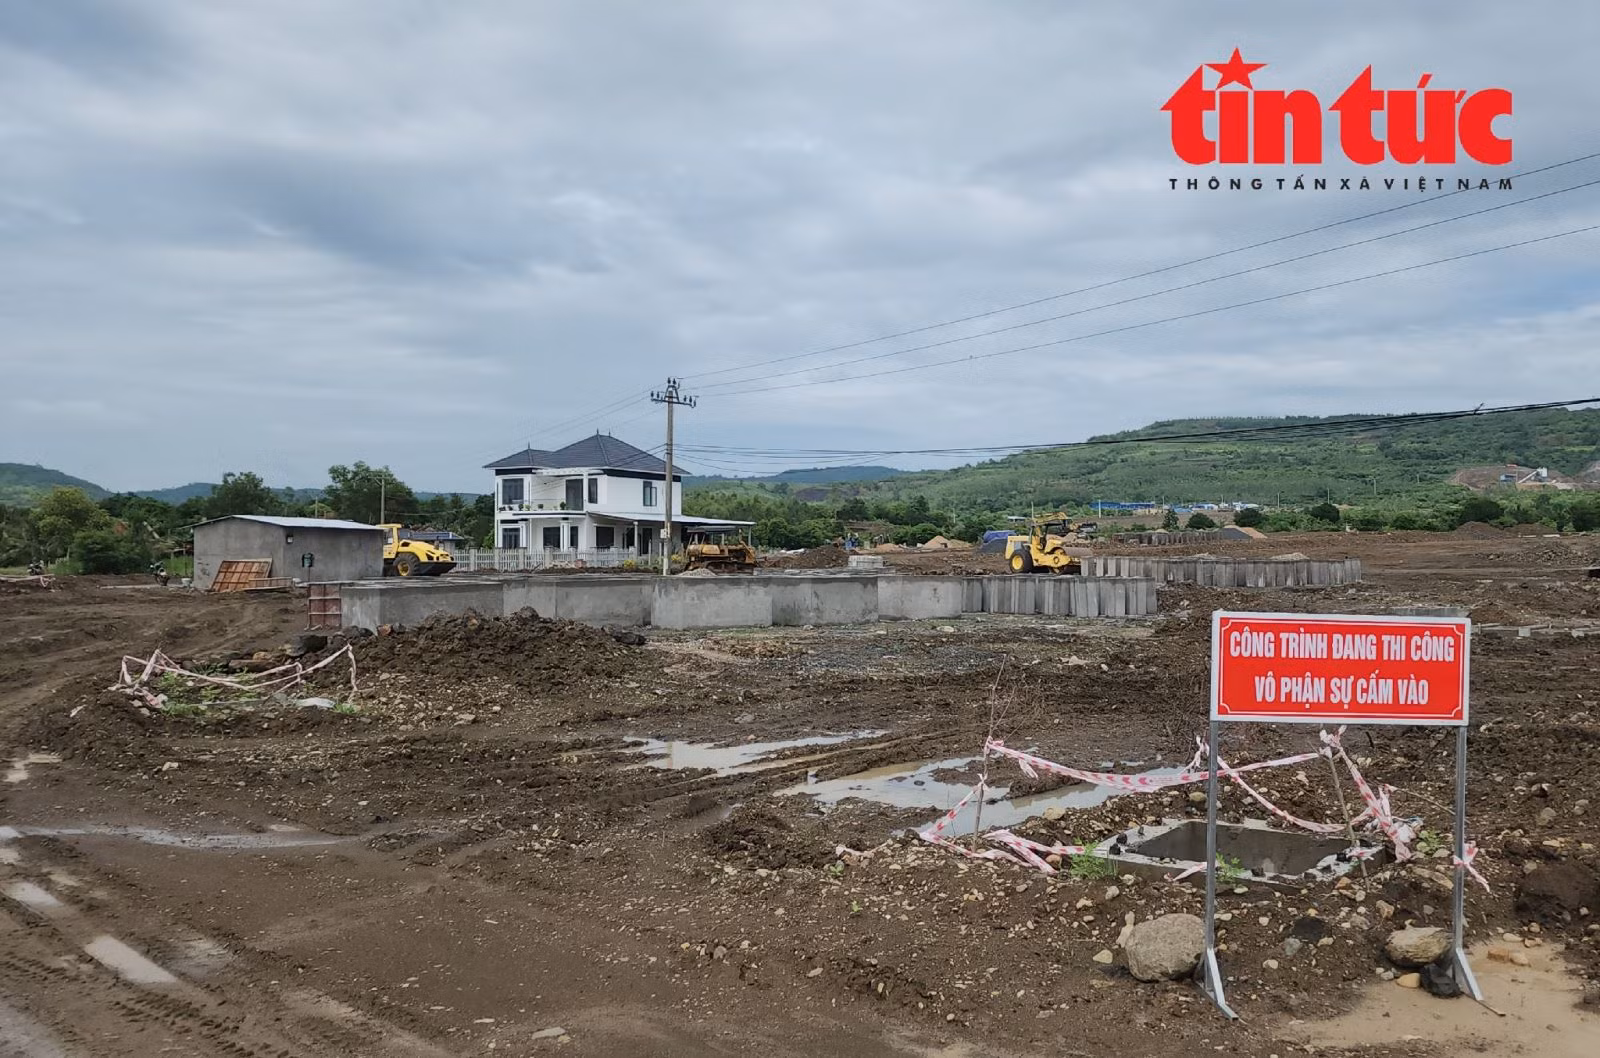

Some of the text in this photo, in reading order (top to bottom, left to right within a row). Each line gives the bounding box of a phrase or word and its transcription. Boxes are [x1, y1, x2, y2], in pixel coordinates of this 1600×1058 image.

[1230, 626, 1455, 662] CÔNG TRÌNH ĐANG THI CÔNG
[1255, 670, 1429, 709] VÔ PHẬN SỰ CẤM VÀO
